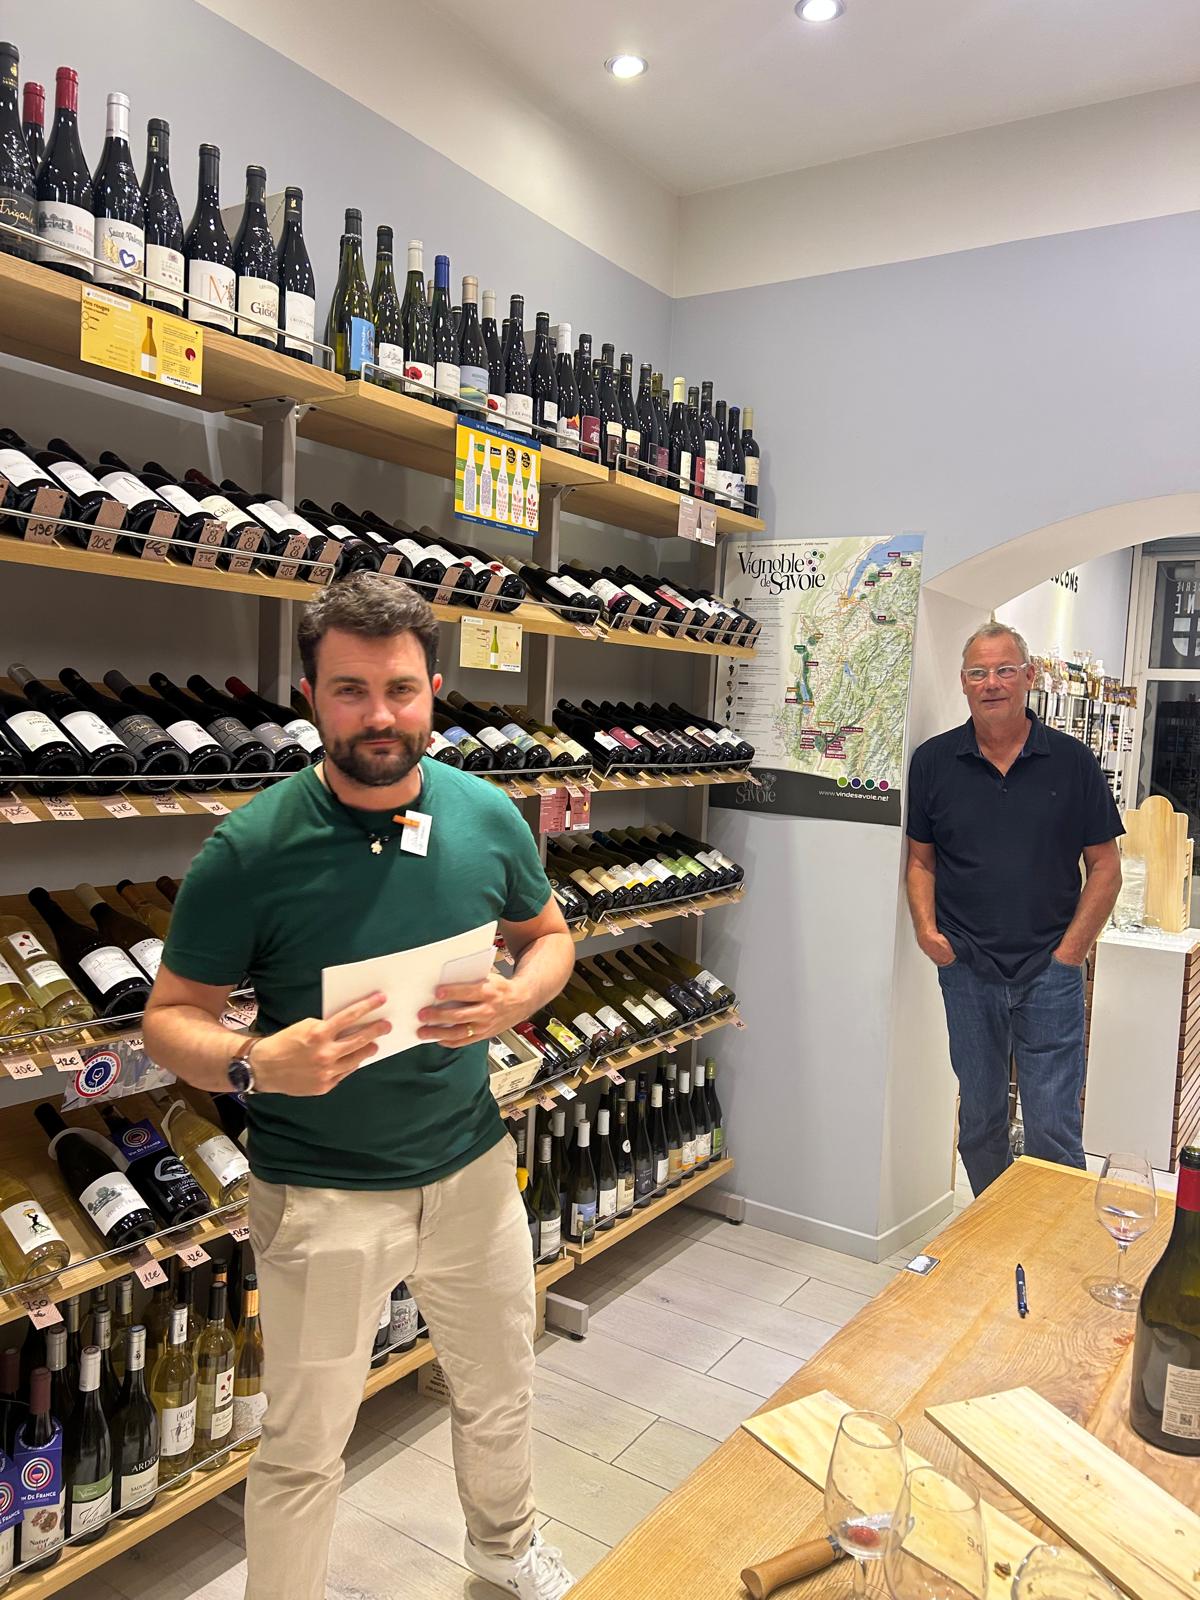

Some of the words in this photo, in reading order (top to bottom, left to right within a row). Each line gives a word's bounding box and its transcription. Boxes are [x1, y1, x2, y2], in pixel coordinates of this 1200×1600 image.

[737, 552, 804, 578] Vignoble
[760, 574, 771, 587] de
[769, 571, 826, 596] Savoie
[819, 790, 889, 802] www.vindesavoie.net
[56, 1056, 79, 1067] 12€
[35, 1491, 57, 1500] FRANCE
